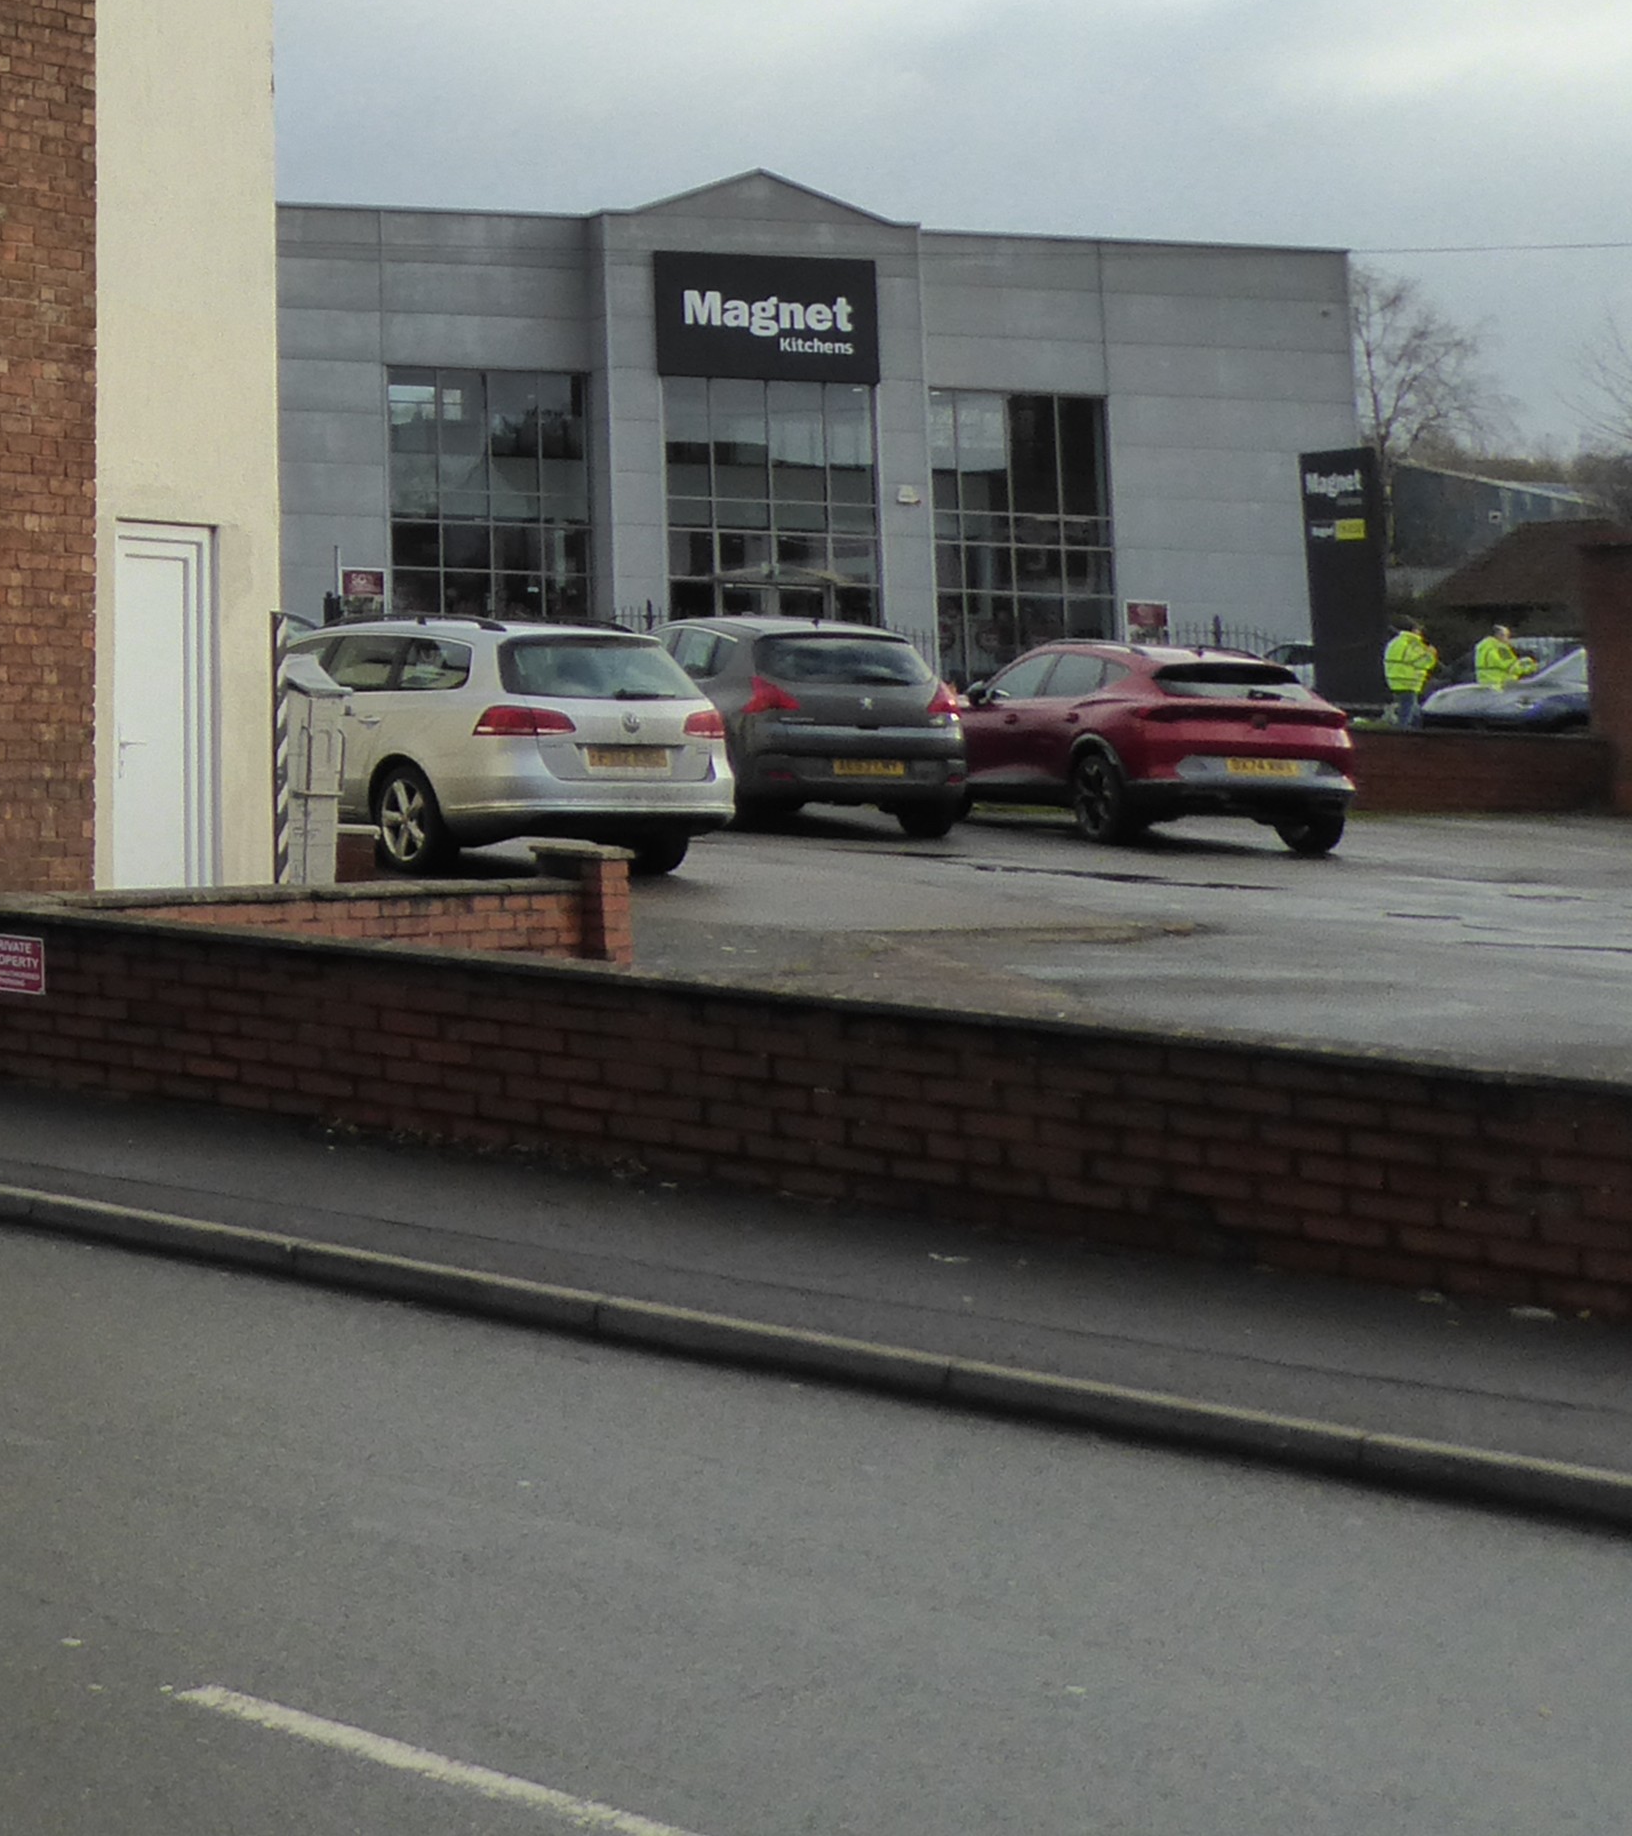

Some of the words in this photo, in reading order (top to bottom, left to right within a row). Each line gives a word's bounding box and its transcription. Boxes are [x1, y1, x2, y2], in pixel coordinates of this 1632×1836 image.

[683, 290, 853, 336] Magnet
[780, 337, 854, 355] Kitchens
[1305, 469, 1363, 497] Magnet
